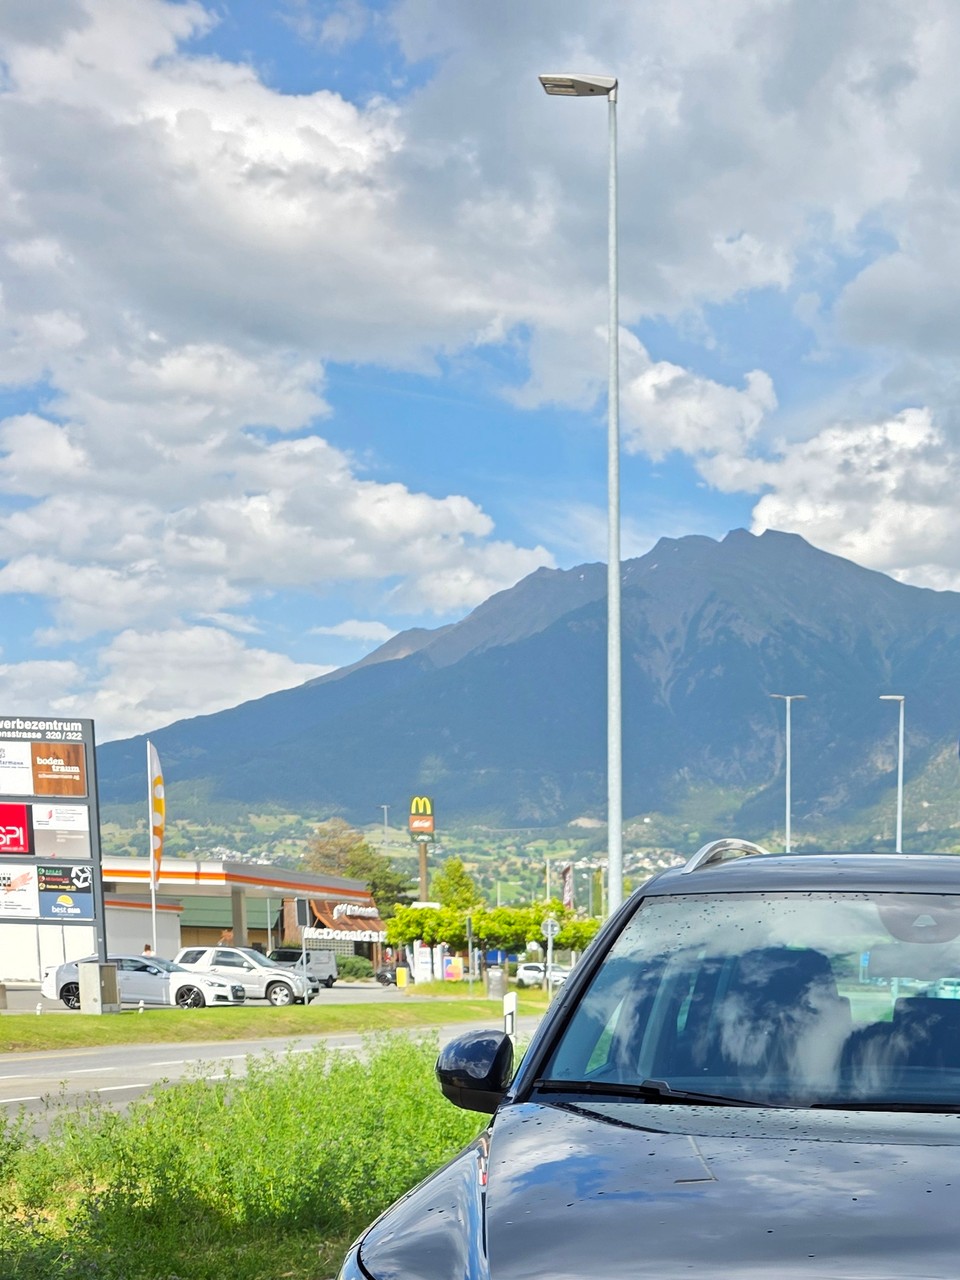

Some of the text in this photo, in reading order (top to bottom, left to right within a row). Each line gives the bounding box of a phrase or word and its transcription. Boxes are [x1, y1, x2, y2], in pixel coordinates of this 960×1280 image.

[0, 730, 42, 739] nsstrasse
[36, 756, 65, 765] boden
[52, 764, 80, 773] traum
